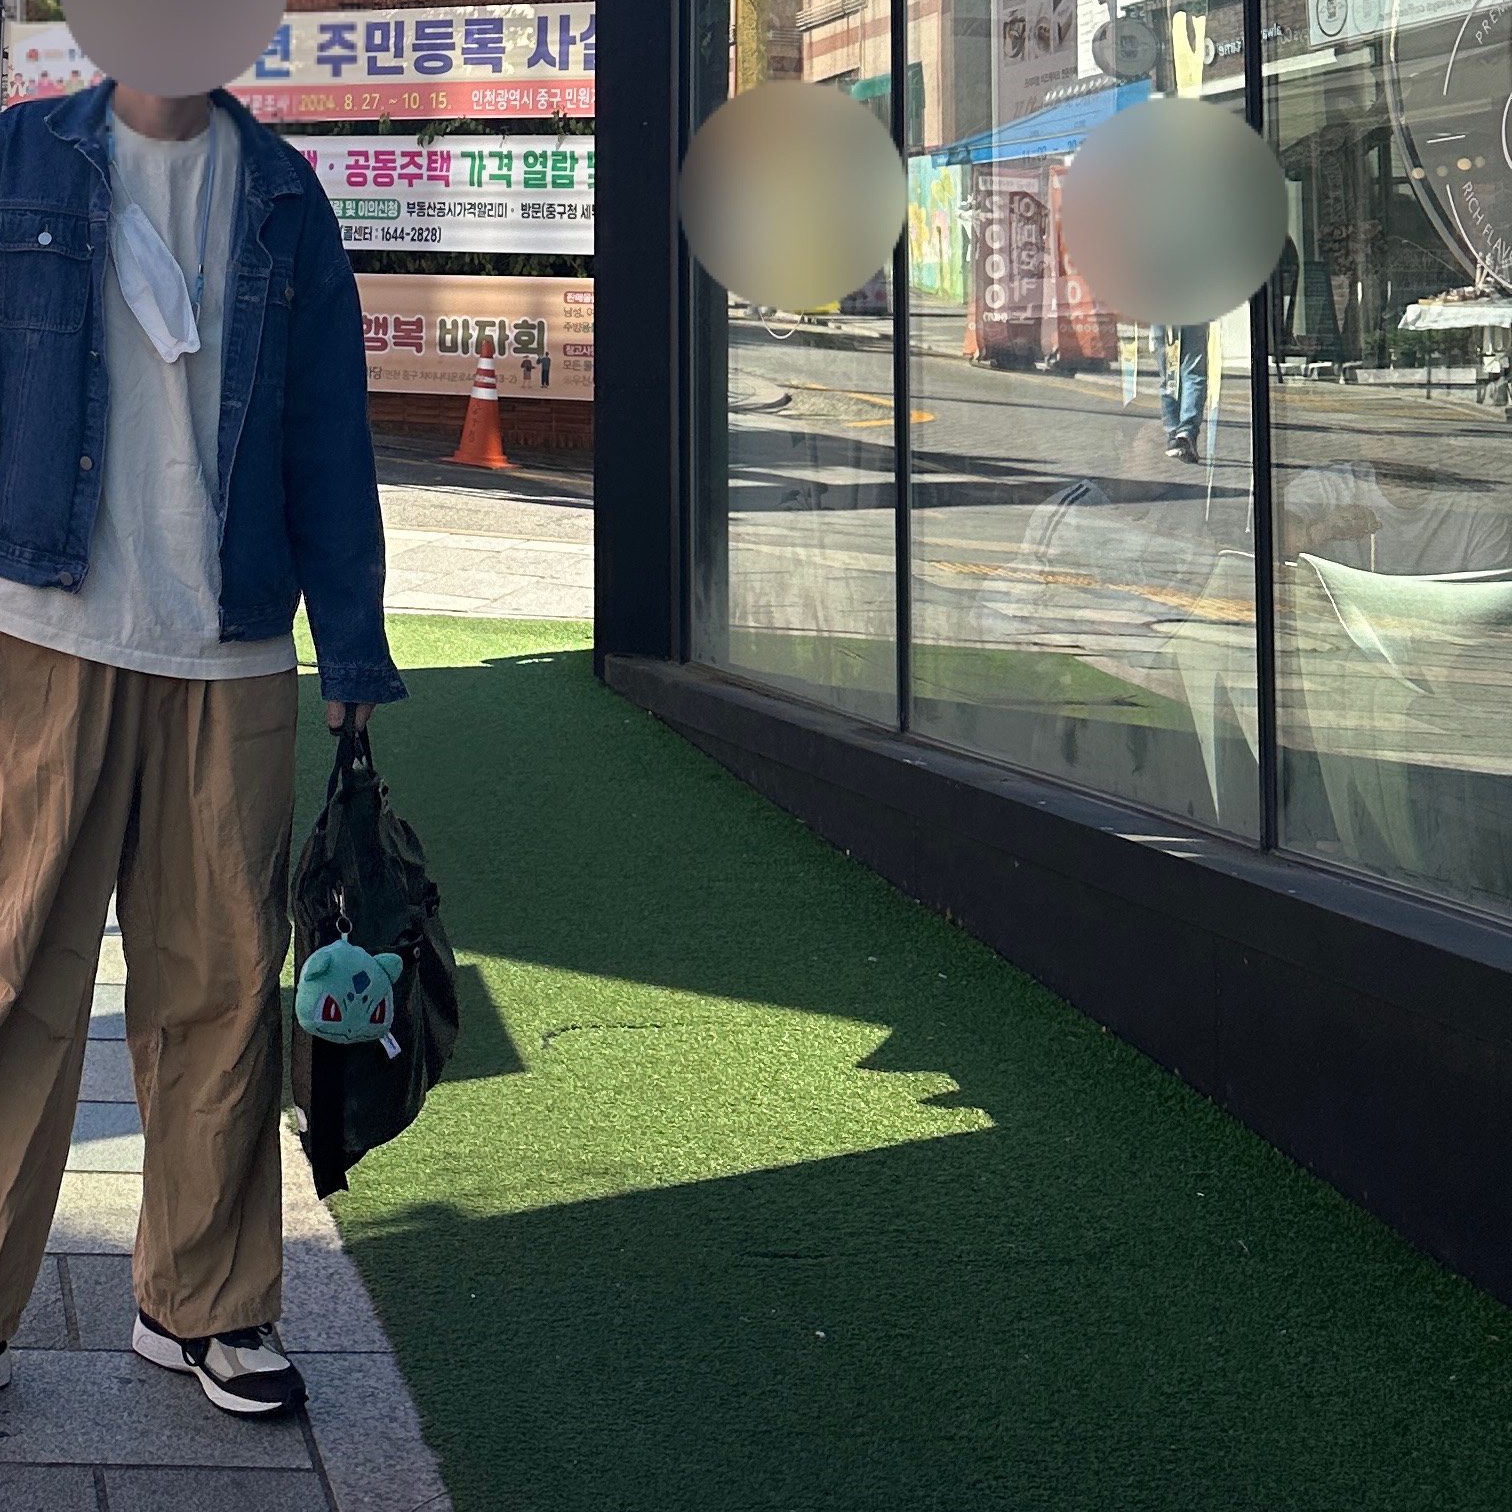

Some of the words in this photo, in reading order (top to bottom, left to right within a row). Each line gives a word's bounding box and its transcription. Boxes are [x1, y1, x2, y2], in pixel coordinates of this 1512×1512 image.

[316, 17, 506, 78] 주민등록
[343, 94, 359, 110] 8.
[361, 94, 385, 110] 27.
[402, 93, 424, 109] 10.
[430, 92, 452, 109] 15.
[471, 90, 534, 111] 인천광역시
[536, 90, 562, 109] 중구
[345, 150, 452, 188] 공동주택
[460, 150, 513, 189] 가격
[523, 150, 579, 189] 열람
[345, 201, 357, 216] 및
[357, 200, 399, 217] 이의신청
[406, 201, 508, 219] 부동산공시가격알리미
[520, 202, 577, 220] 방문(중구청
[1462, 180, 1485, 227] RICH
[380, 225, 442, 243] 1644-2828)
[363, 314, 425, 354] 행복
[438, 318, 546, 357] 바자회
[402, 370, 419, 381] 중구
[419, 370, 476, 383] 차이나타운로4
[563, 360, 581, 372] 모든
